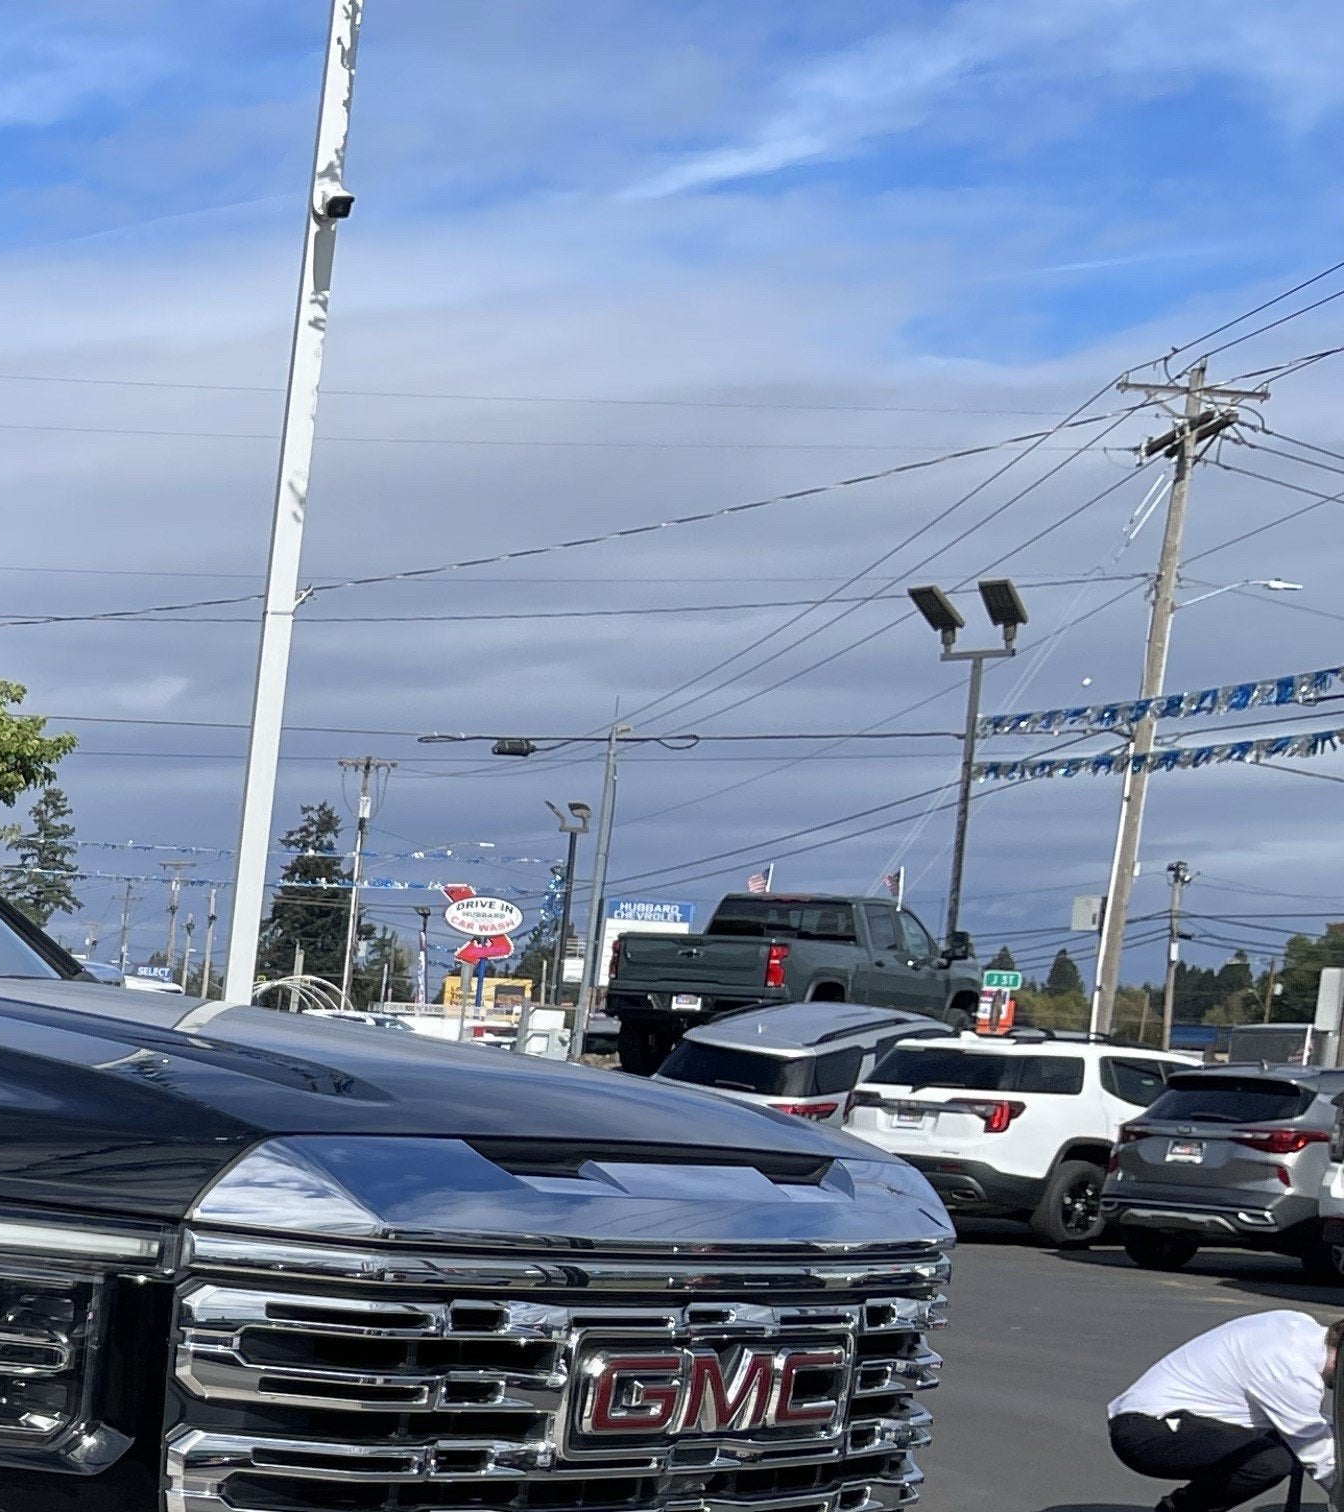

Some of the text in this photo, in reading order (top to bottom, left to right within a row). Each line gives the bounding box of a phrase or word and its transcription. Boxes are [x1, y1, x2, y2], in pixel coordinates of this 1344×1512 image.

[456, 900, 514, 914] DRIVE IN
[619, 902, 680, 913] HUBBARD
[614, 909, 683, 922] CHEVROLET
[451, 915, 515, 932] CAR WASH
[137, 966, 170, 977] SELECT
[1001, 975, 1017, 986] ST
[582, 1347, 846, 1434] GMC
